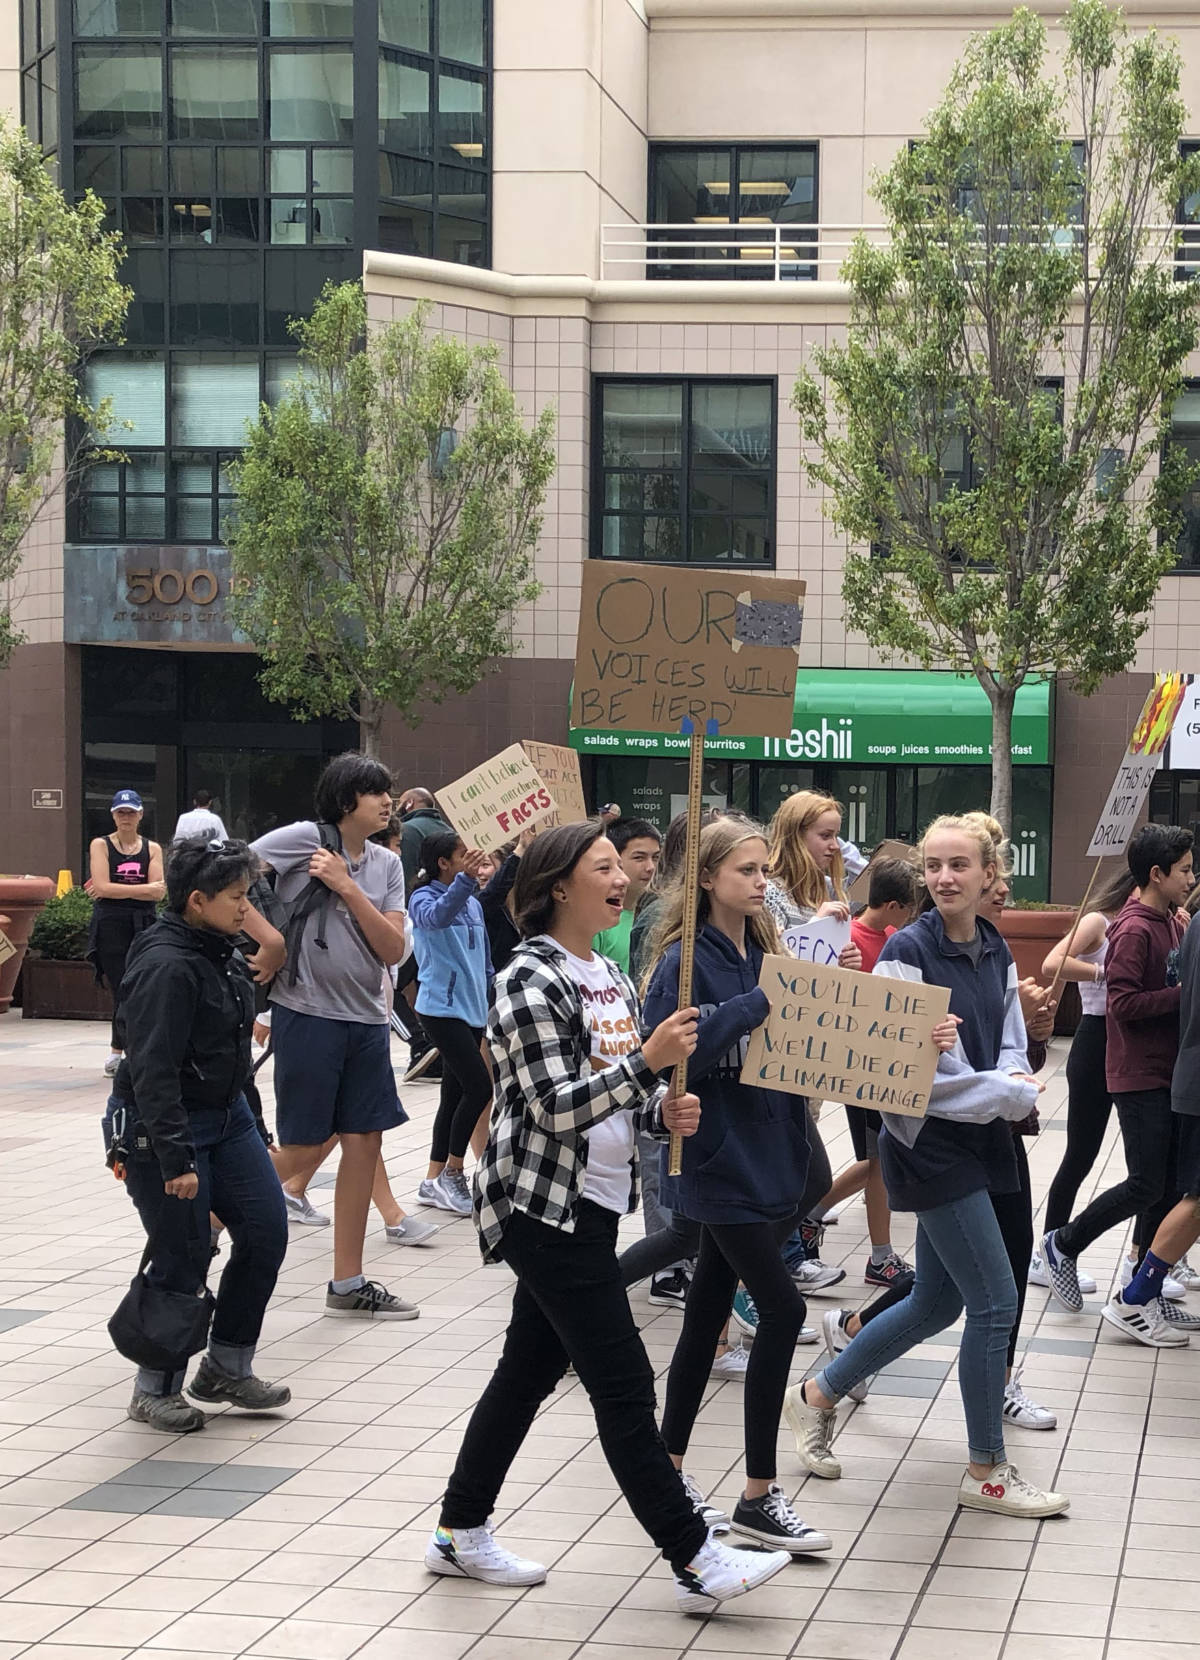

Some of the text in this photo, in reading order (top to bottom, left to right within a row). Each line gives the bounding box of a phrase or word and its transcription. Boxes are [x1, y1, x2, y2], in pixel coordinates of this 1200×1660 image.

[126, 567, 218, 605] 500
[597, 578, 736, 645] OUR
[592, 648, 792, 693] VOICES WILL
[581, 688, 632, 725] BE
[552, 748, 576, 769] YOU
[584, 735, 619, 746] salads
[625, 737, 658, 749] wraps
[664, 737, 691, 748] bowl
[868, 745, 897, 756] soups
[901, 744, 929, 756] juices
[934, 744, 983, 755] smoothies
[447, 795, 457, 809] I
[488, 758, 529, 785] believe
[633, 786, 663, 796] salads
[1117, 766, 1155, 790] THIS IS
[458, 808, 482, 831] that
[474, 788, 551, 849] for FACTS
[633, 802, 661, 811] wraps
[1110, 795, 1138, 816] NOT A
[1094, 823, 1125, 846] DRILL
[776, 971, 928, 1016] YOU'LL DIE
[780, 1003, 923, 1049] OF OLD AGE,
[764, 1028, 832, 1063] WE'LL
[846, 1046, 881, 1073] DIE
[888, 1060, 919, 1079] OF
[760, 1060, 926, 1109] CLIMATE CHANGE
